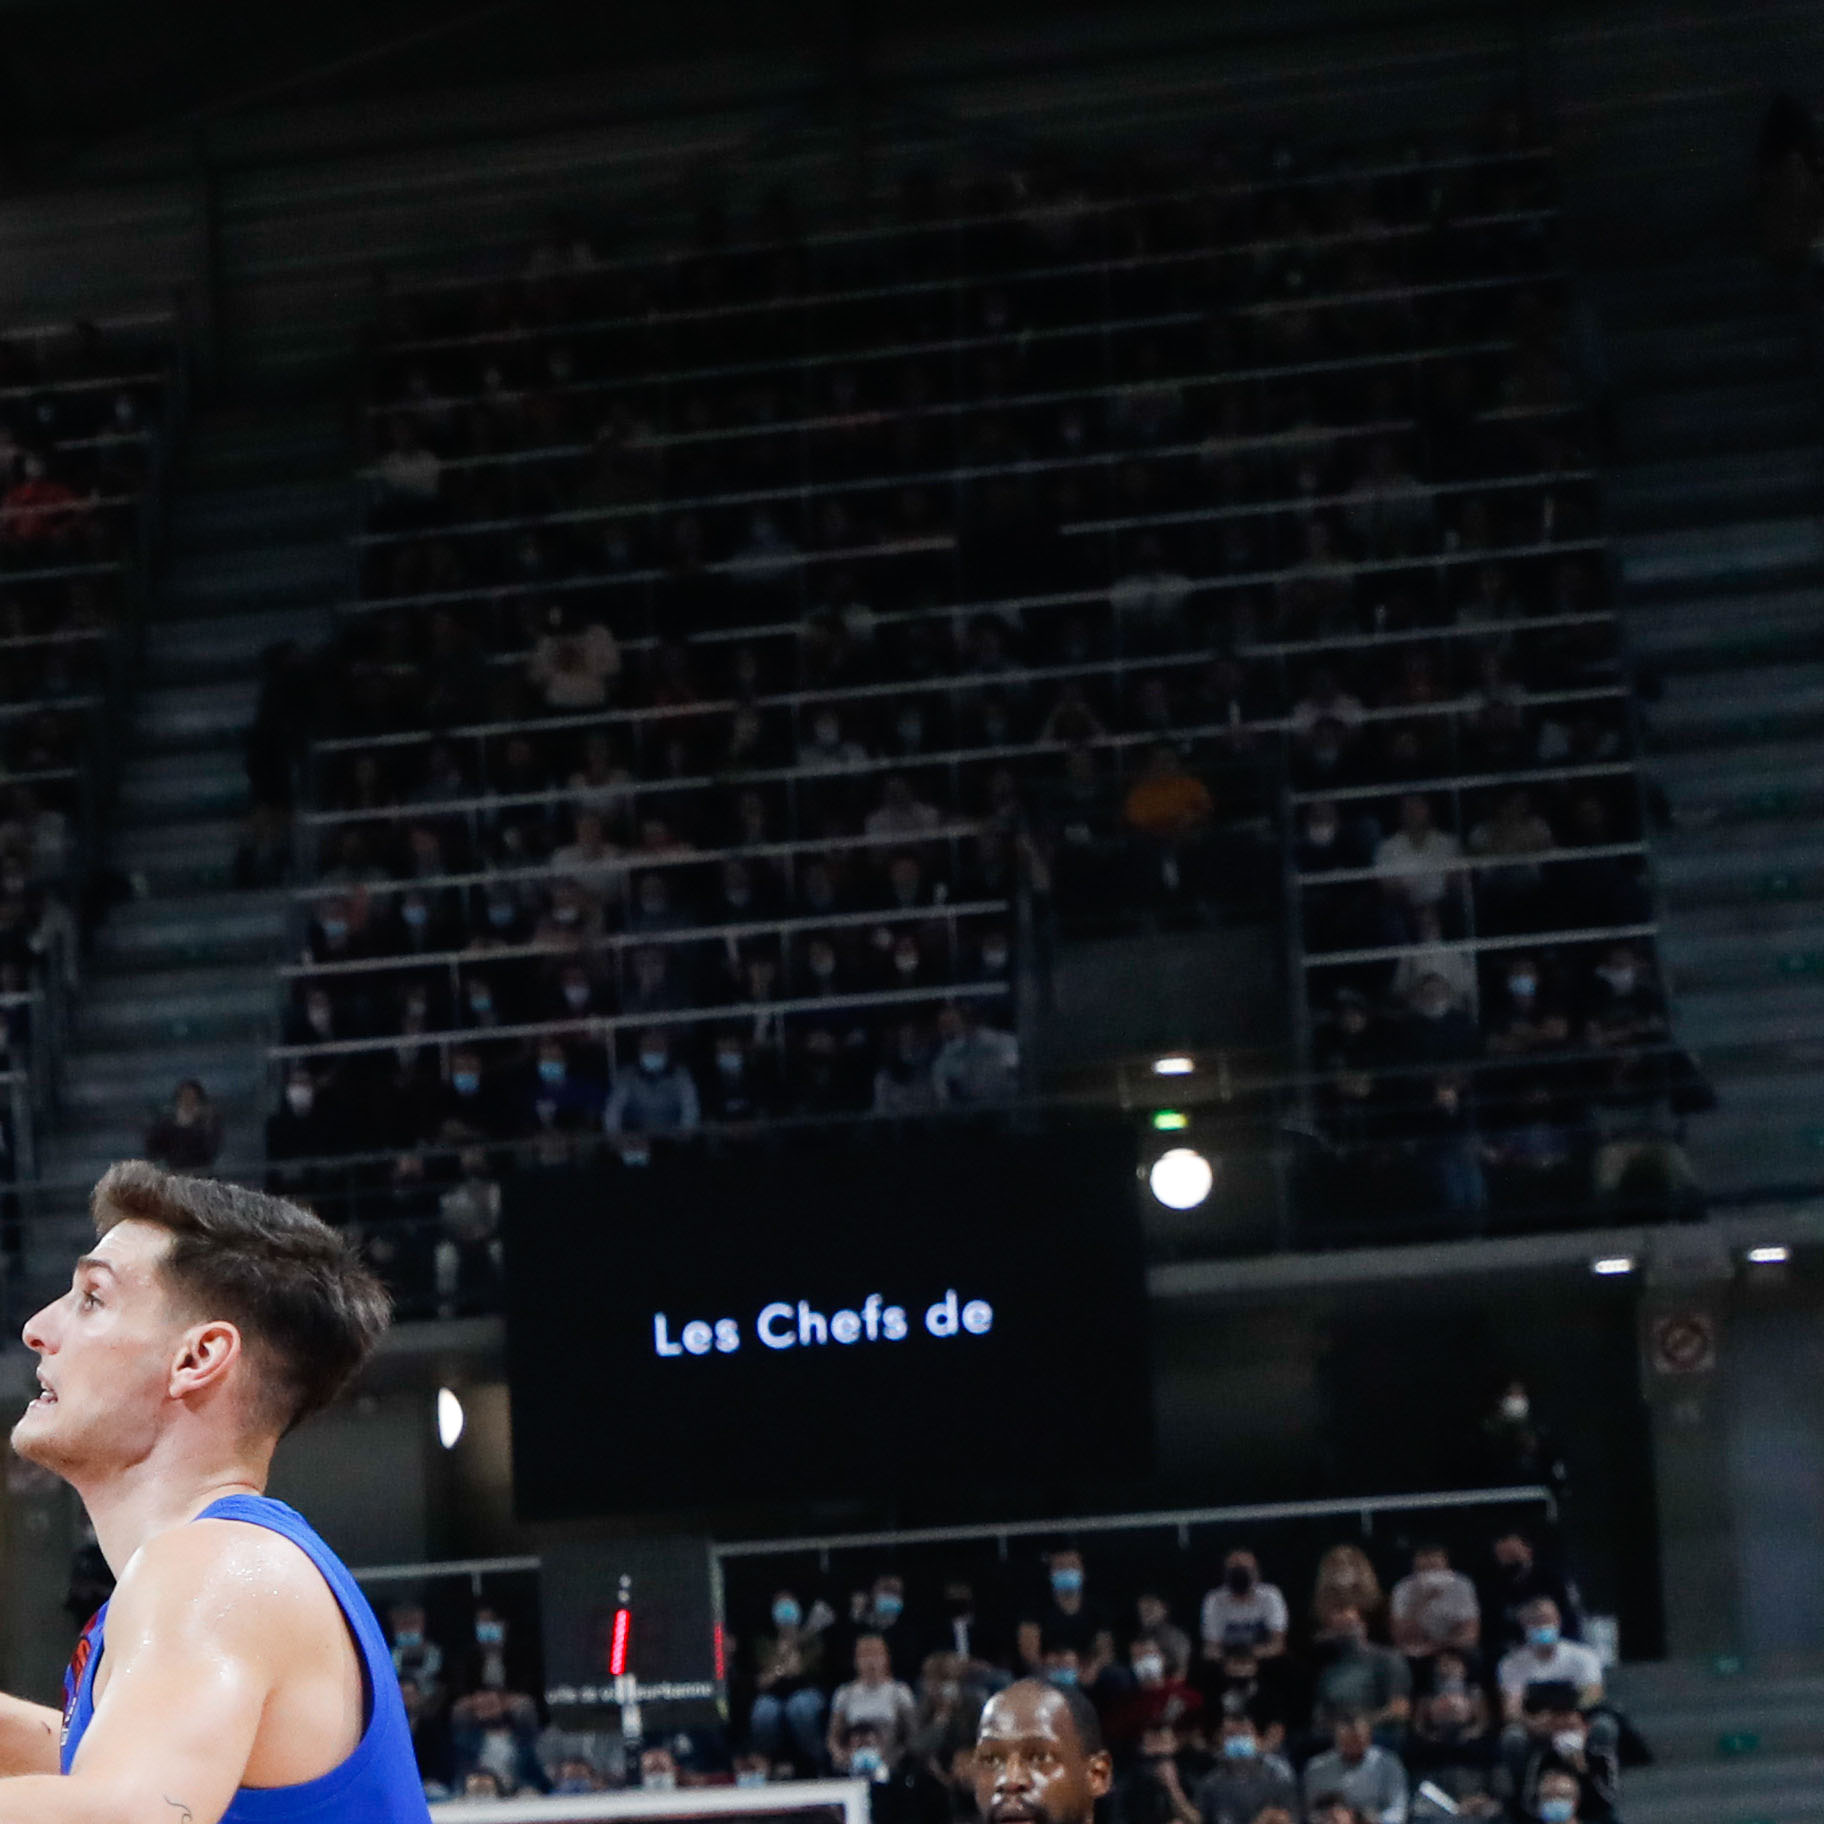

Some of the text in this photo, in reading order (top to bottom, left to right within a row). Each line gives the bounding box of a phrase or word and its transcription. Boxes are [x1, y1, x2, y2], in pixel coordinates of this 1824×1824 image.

[654, 1288, 993, 1357] Les Chefs de
